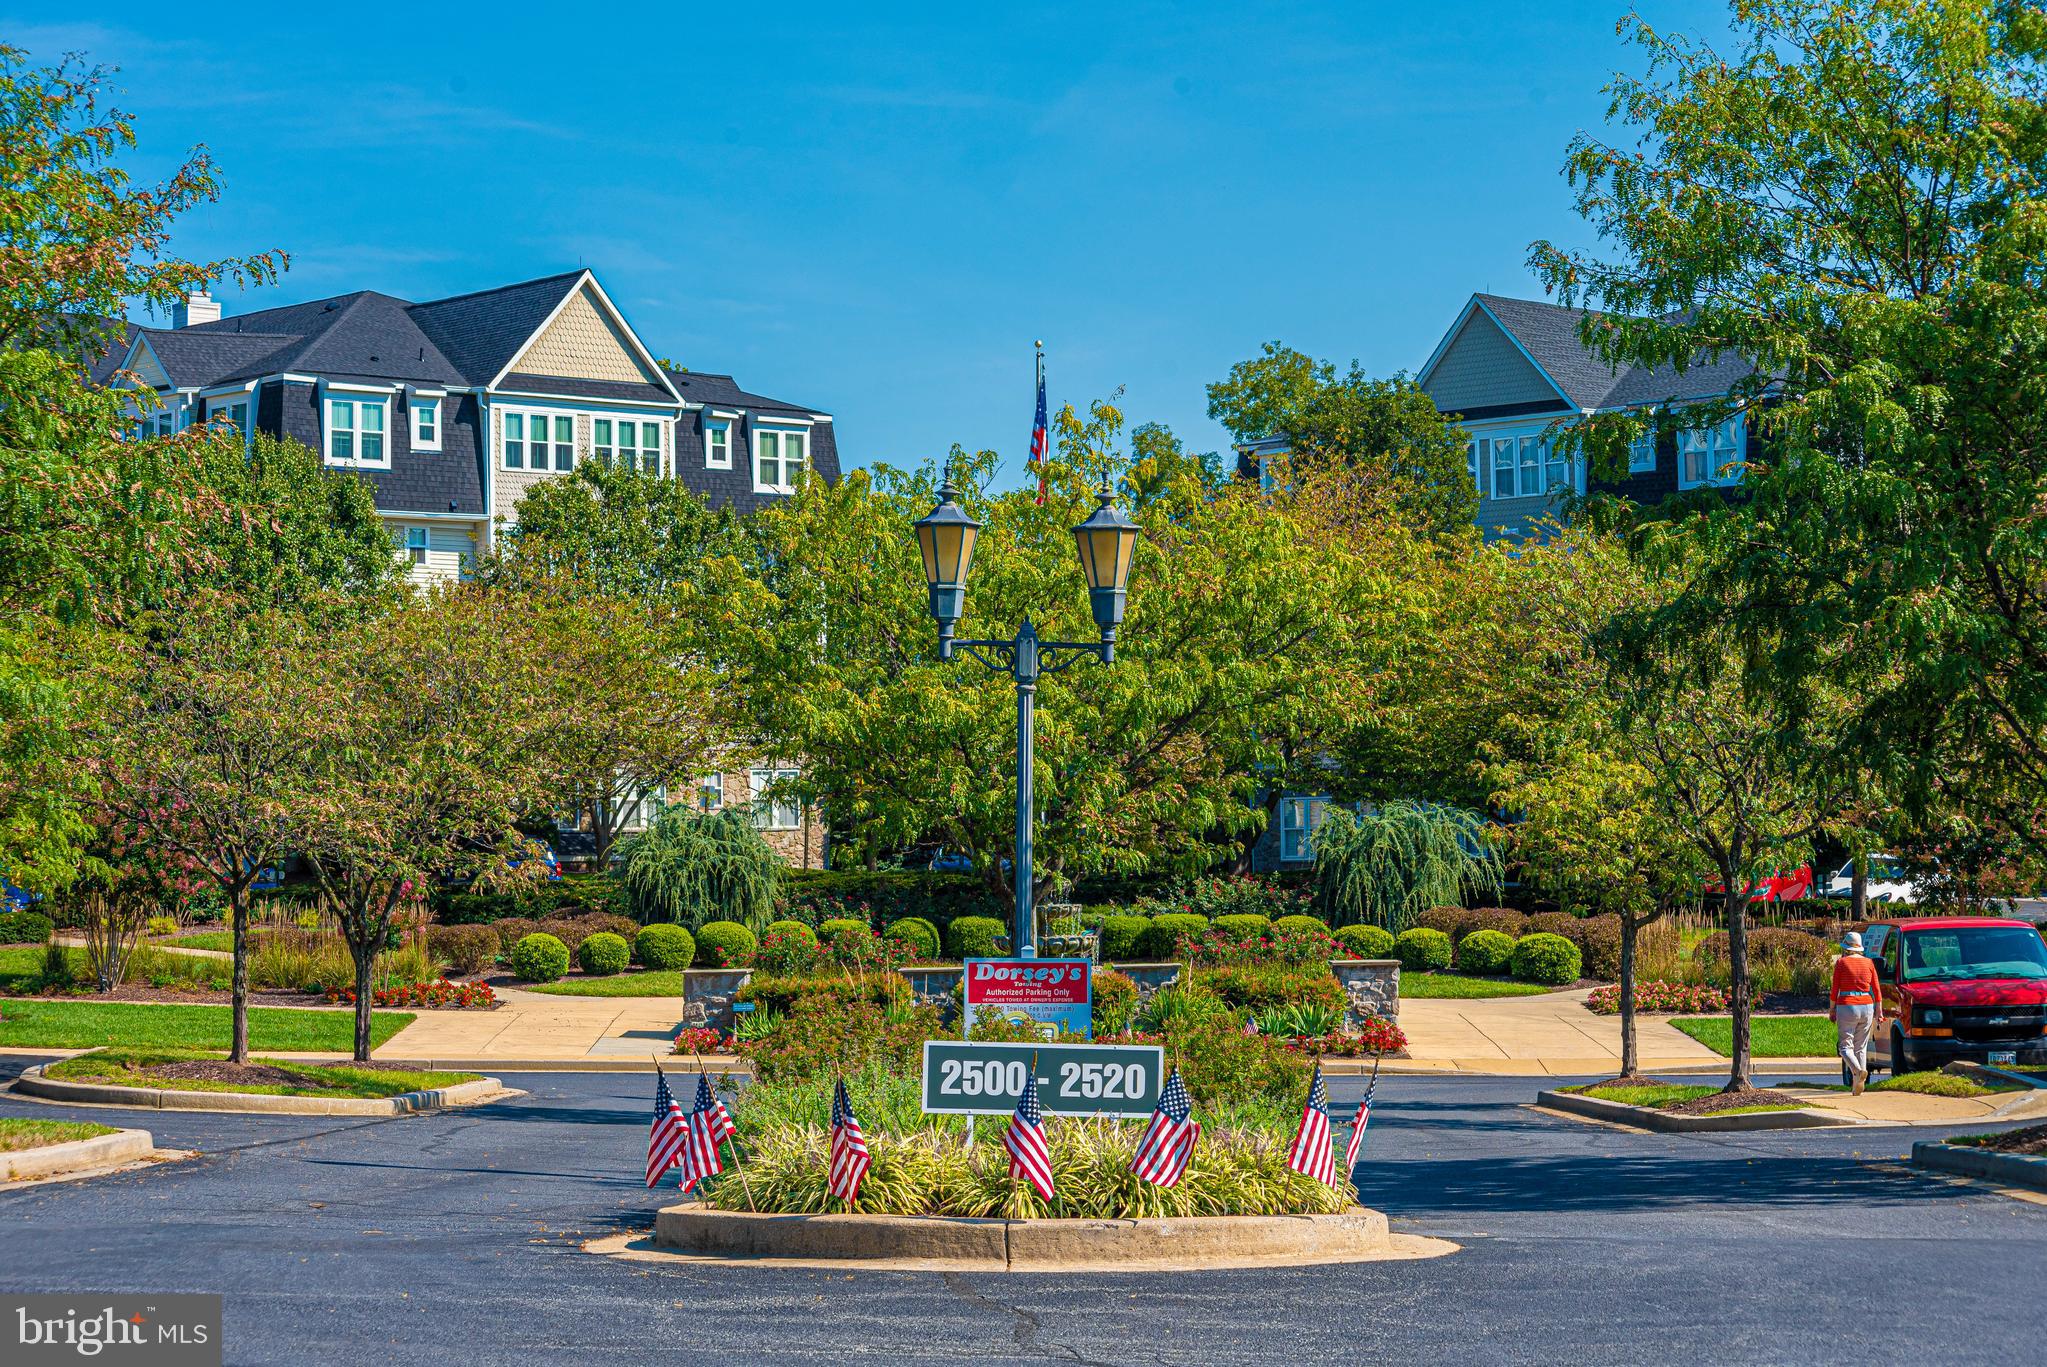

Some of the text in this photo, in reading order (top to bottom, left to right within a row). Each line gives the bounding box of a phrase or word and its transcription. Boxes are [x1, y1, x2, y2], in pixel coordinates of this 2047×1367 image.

[974, 963, 1082, 984] Dorsey's
[986, 988, 1070, 997] Authorized Parking Only
[940, 1059, 1146, 1099] 2500 - 2520
